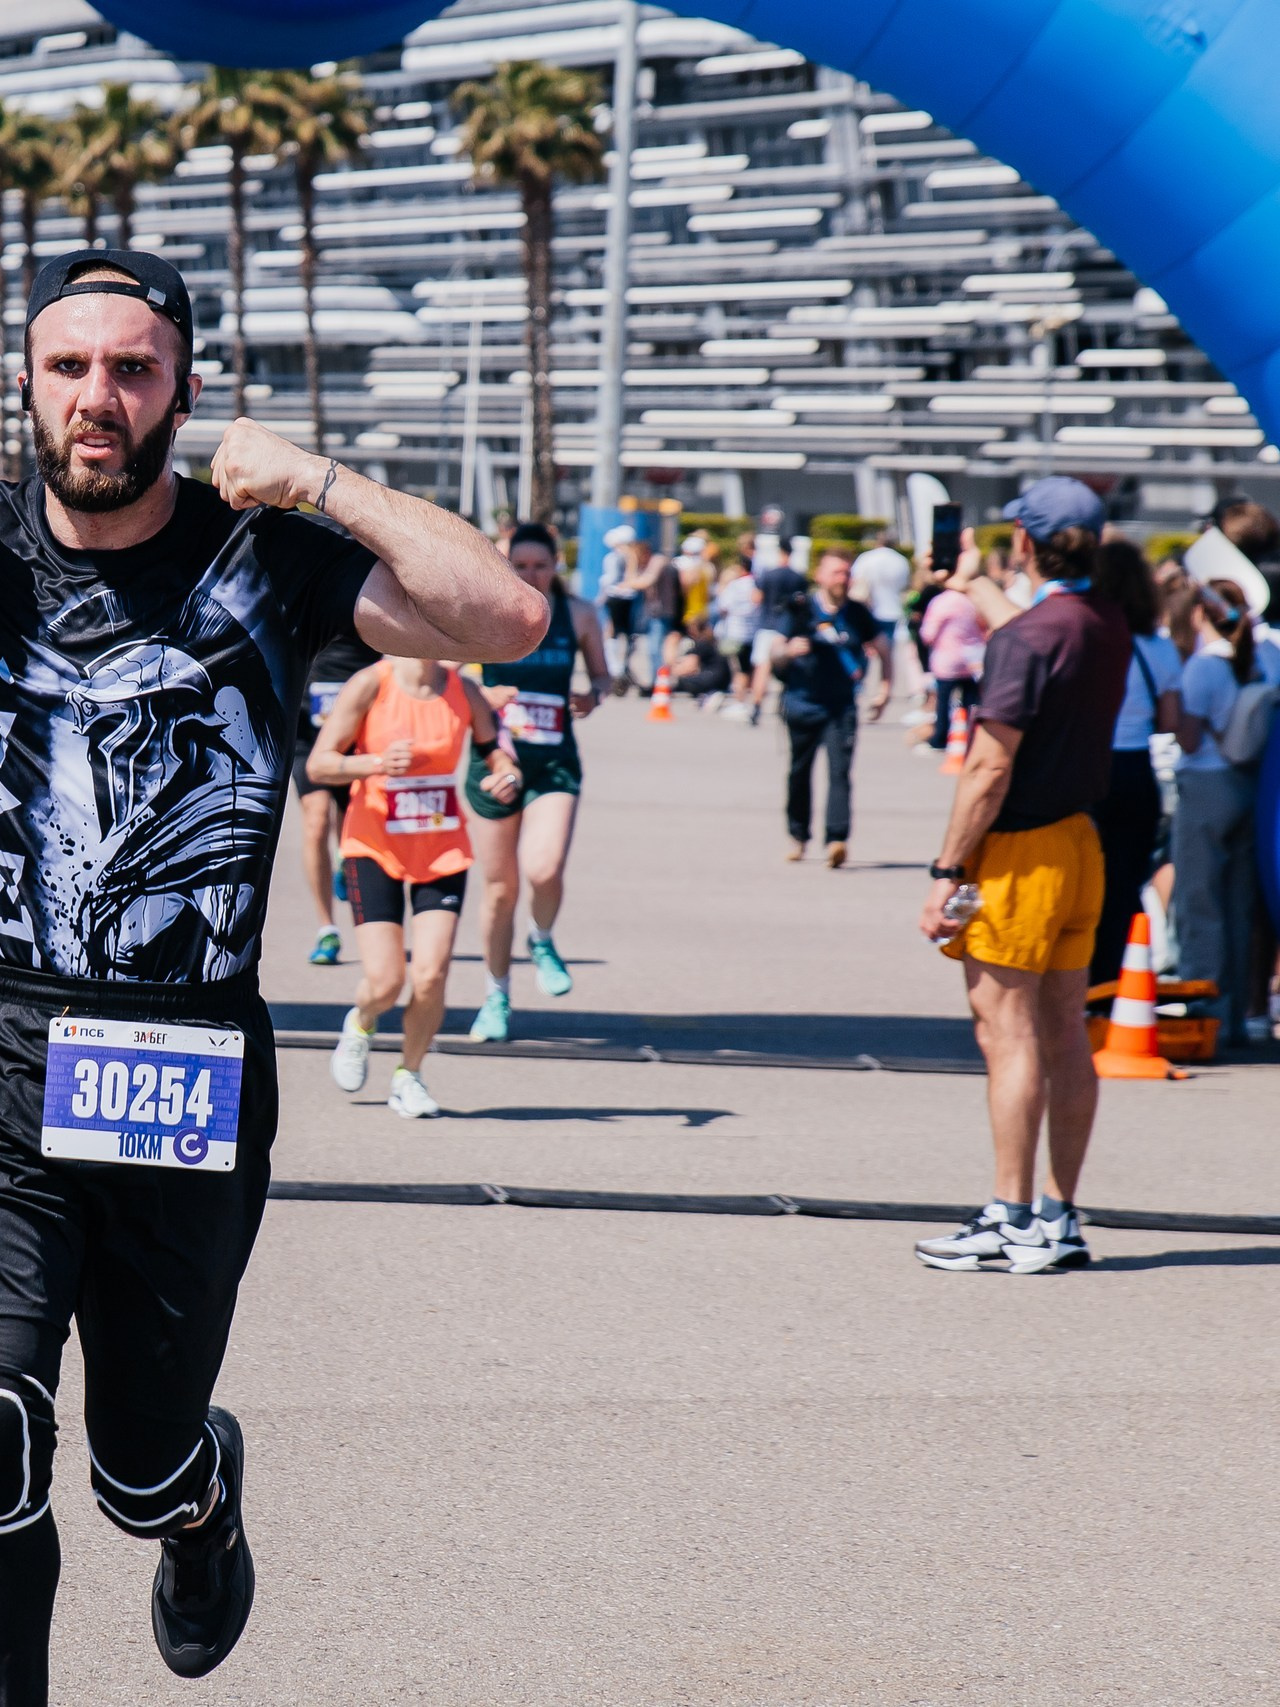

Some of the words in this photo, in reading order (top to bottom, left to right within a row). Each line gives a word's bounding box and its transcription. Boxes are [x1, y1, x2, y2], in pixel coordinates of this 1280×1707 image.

[80, 1027, 105, 1038] ПСБ
[71, 1058, 214, 1128] 30254
[117, 1131, 163, 1160] 10КМ
